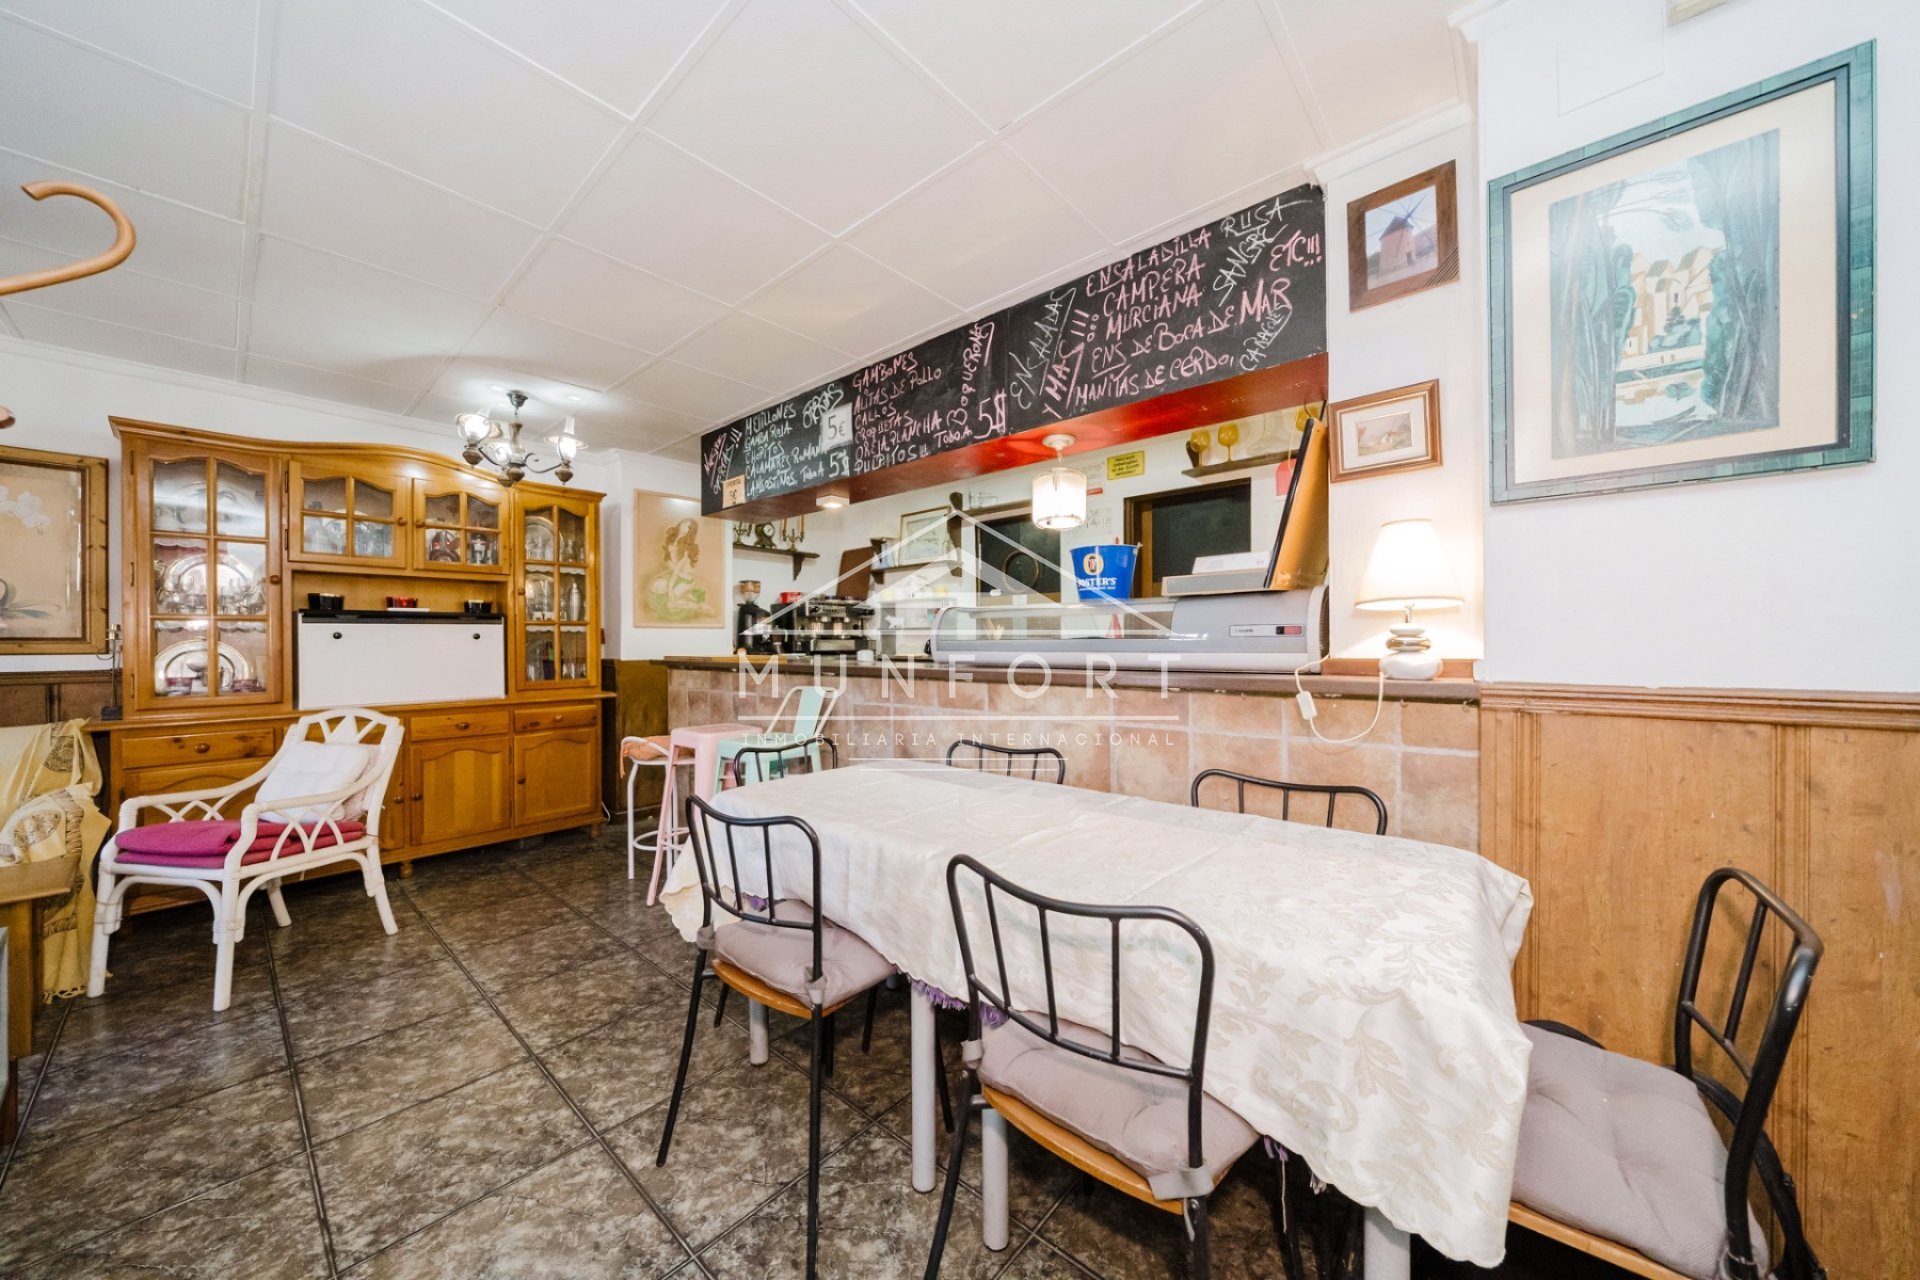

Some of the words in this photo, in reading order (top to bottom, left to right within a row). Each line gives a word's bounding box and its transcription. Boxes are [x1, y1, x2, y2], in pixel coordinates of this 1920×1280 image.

[1220, 197, 1312, 237] RUSA
[1086, 228, 1211, 297] ENSALADILLA
[1213, 224, 1288, 307] SANGRE
[1103, 253, 1205, 318] CAMPERA
[1240, 278, 1292, 324] MAR
[1106, 283, 1203, 340] MURCIANA
[853, 352, 918, 392] GAMBONES
[854, 387, 888, 414] ALITAS
[910, 367, 941, 389] POLLO
[1076, 364, 1139, 407] MANITAS
[1144, 365, 1165, 389] DE
[828, 414, 846, 440] 5€
[855, 402, 896, 429] CALLOS
[855, 410, 913, 444] CROQUETAS
[890, 410, 942, 446] PLANCHA
